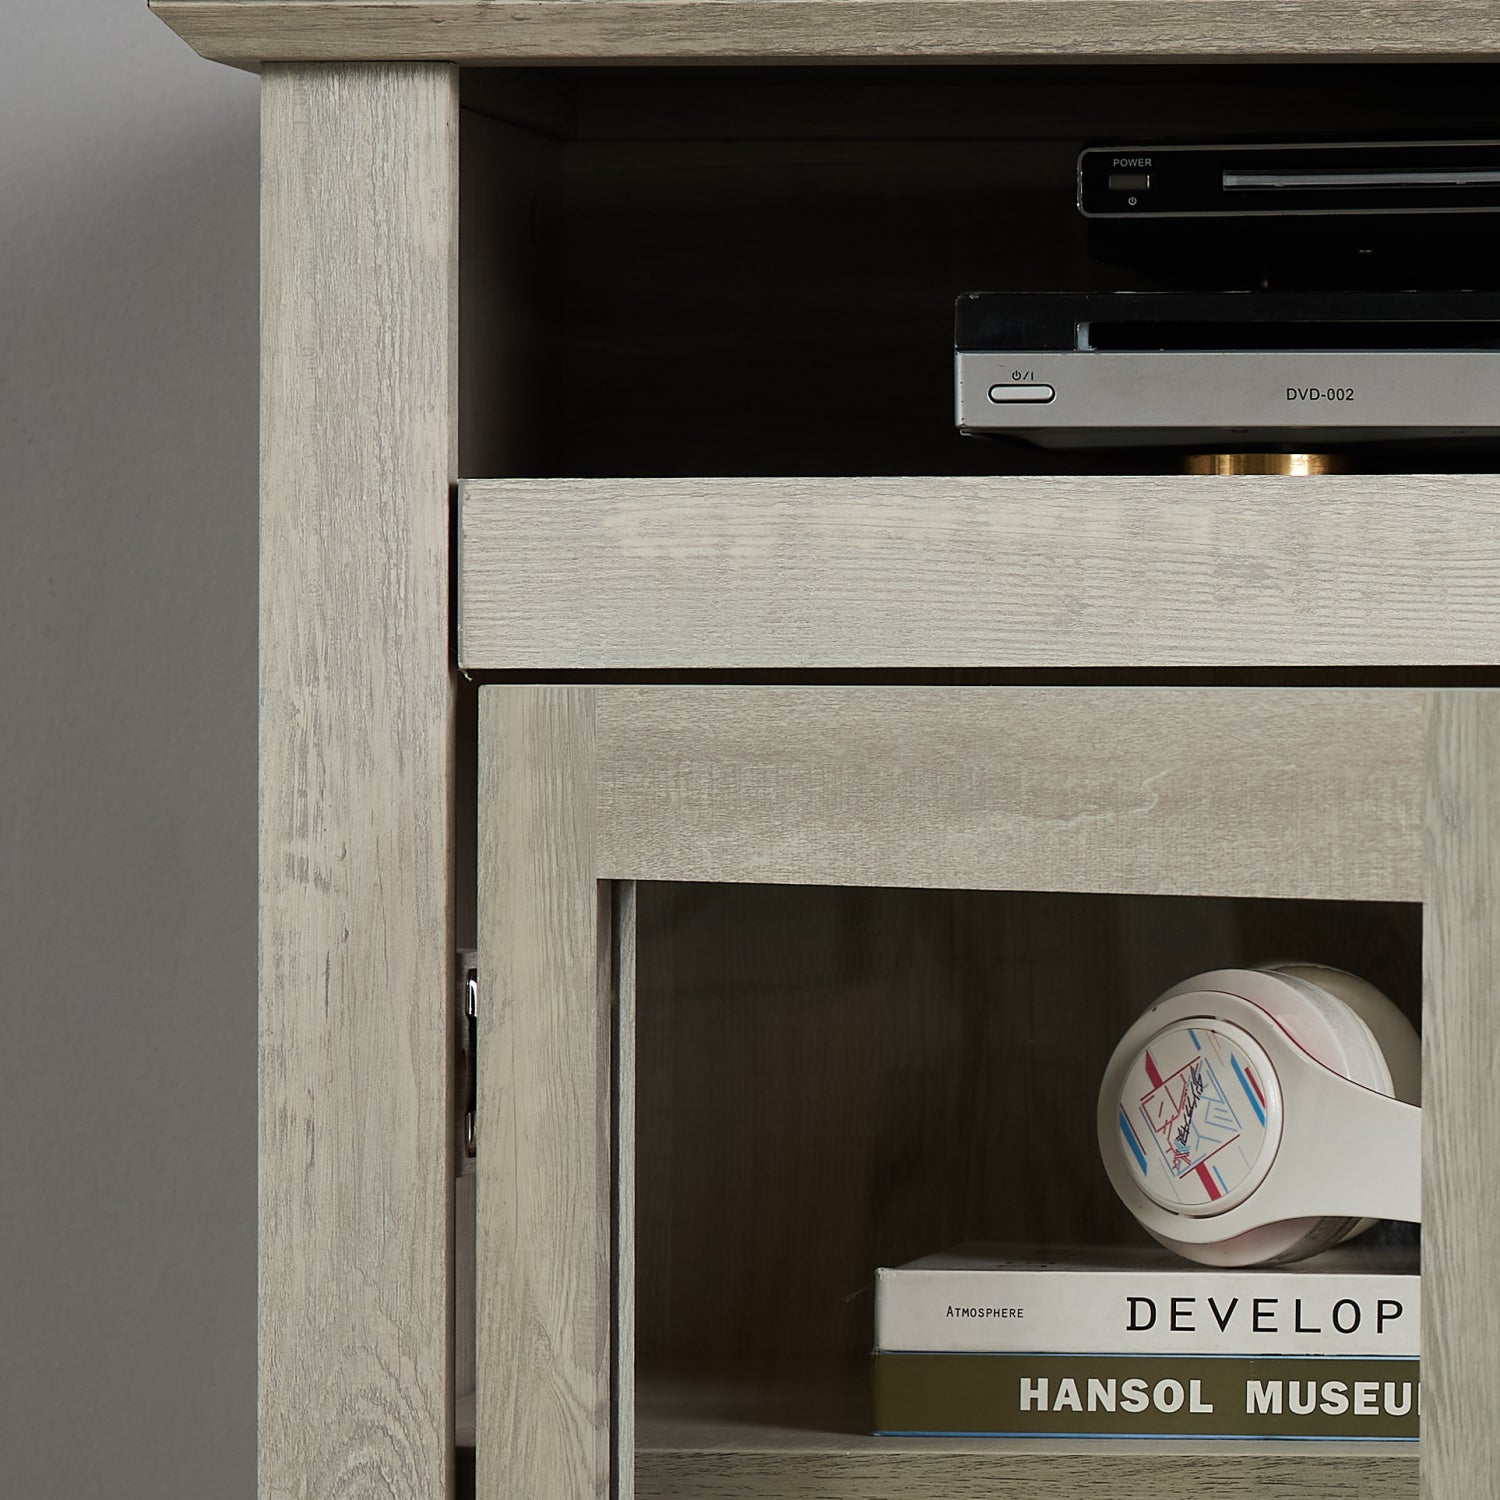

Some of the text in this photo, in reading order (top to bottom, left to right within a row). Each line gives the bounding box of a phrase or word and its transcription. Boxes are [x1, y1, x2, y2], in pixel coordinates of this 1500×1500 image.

[1113, 158, 1152, 168] POWER
[1286, 387, 1355, 401] DVD-002
[1126, 1296, 1404, 1334] DEVELOP
[1019, 1376, 1420, 1416] HANSOL MUSEU
